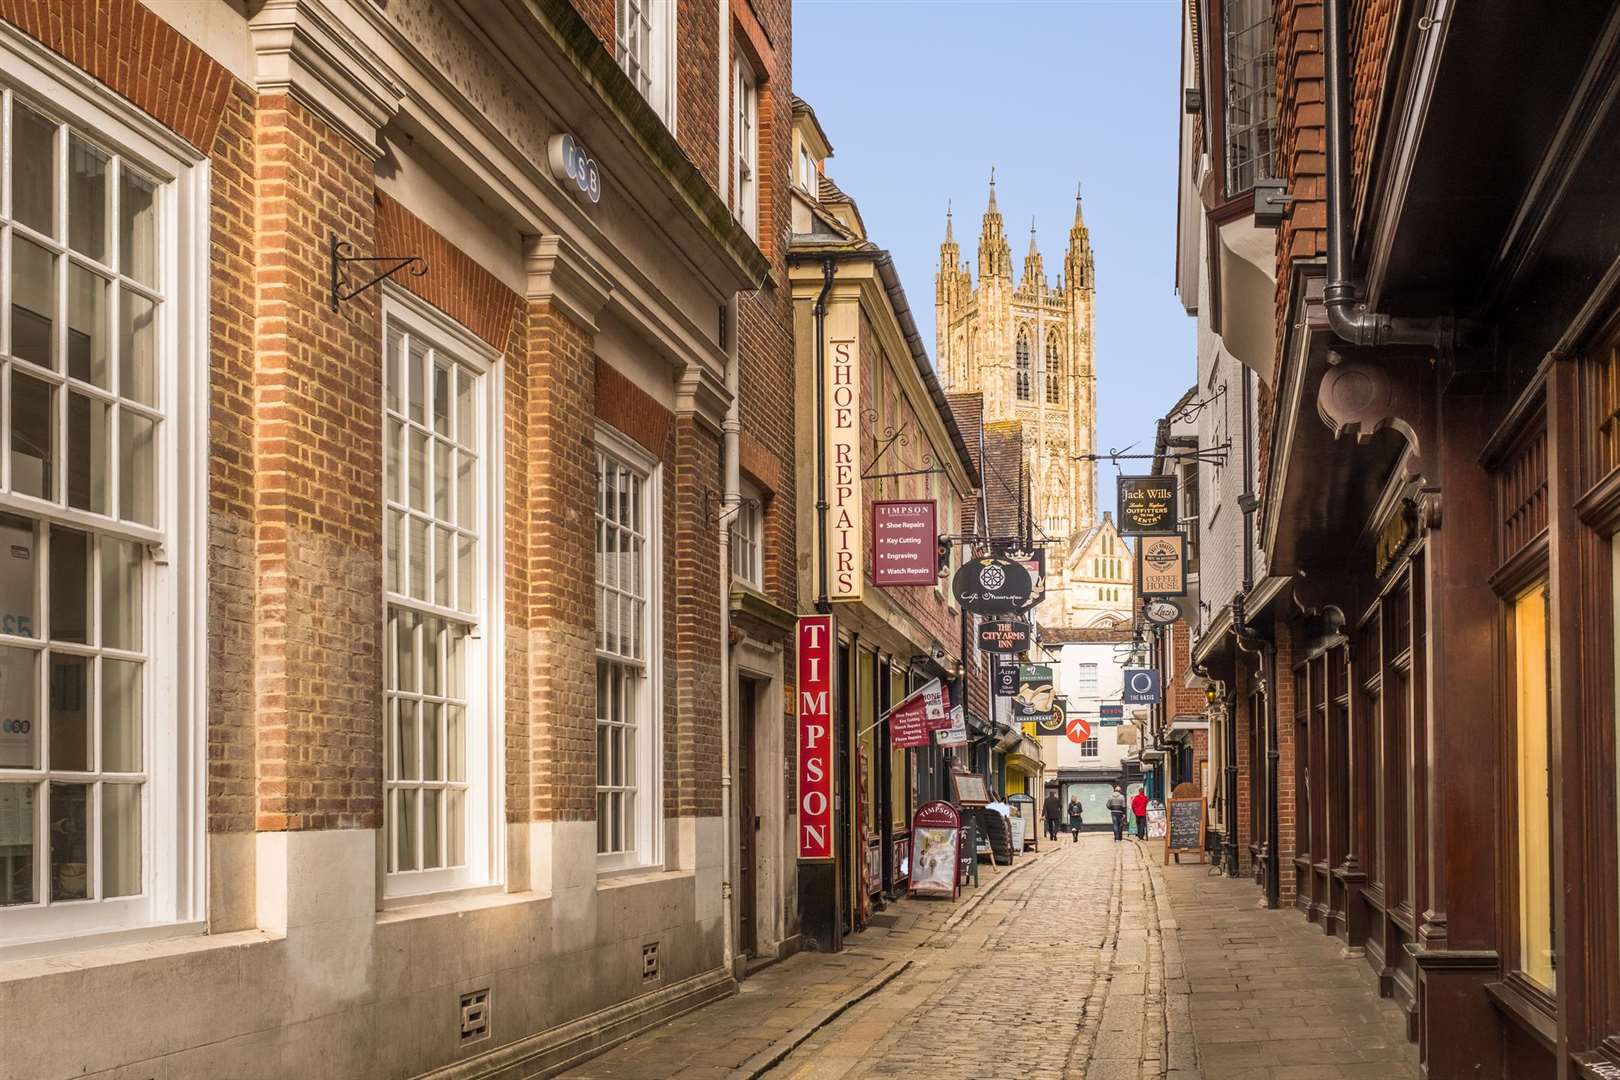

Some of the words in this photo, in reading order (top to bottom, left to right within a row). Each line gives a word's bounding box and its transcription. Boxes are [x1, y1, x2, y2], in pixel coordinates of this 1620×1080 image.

[834, 343, 853, 429] SHOE
[1122, 489, 1144, 502] Jack
[1146, 489, 1172, 499] Wills
[880, 506, 928, 515] TIMPSON
[834, 443, 854, 593] REPAIRS
[1132, 514, 1161, 524] GENTRY
[902, 521, 925, 530] Repairs
[886, 537, 898, 545] Key
[899, 536, 922, 545] Cutting
[886, 552, 918, 561] Engraving
[907, 567, 929, 575] Repairs
[1146, 575, 1177, 583] COFFEE
[1146, 582, 1178, 590] HOUSE
[996, 623, 1013, 632] THE
[982, 631, 1002, 640] CITY
[1002, 631, 1025, 640] ARMS
[998, 640, 1013, 648] INN
[801, 624, 828, 849] TIMPSON
[919, 806, 954, 819] TIMPSON
